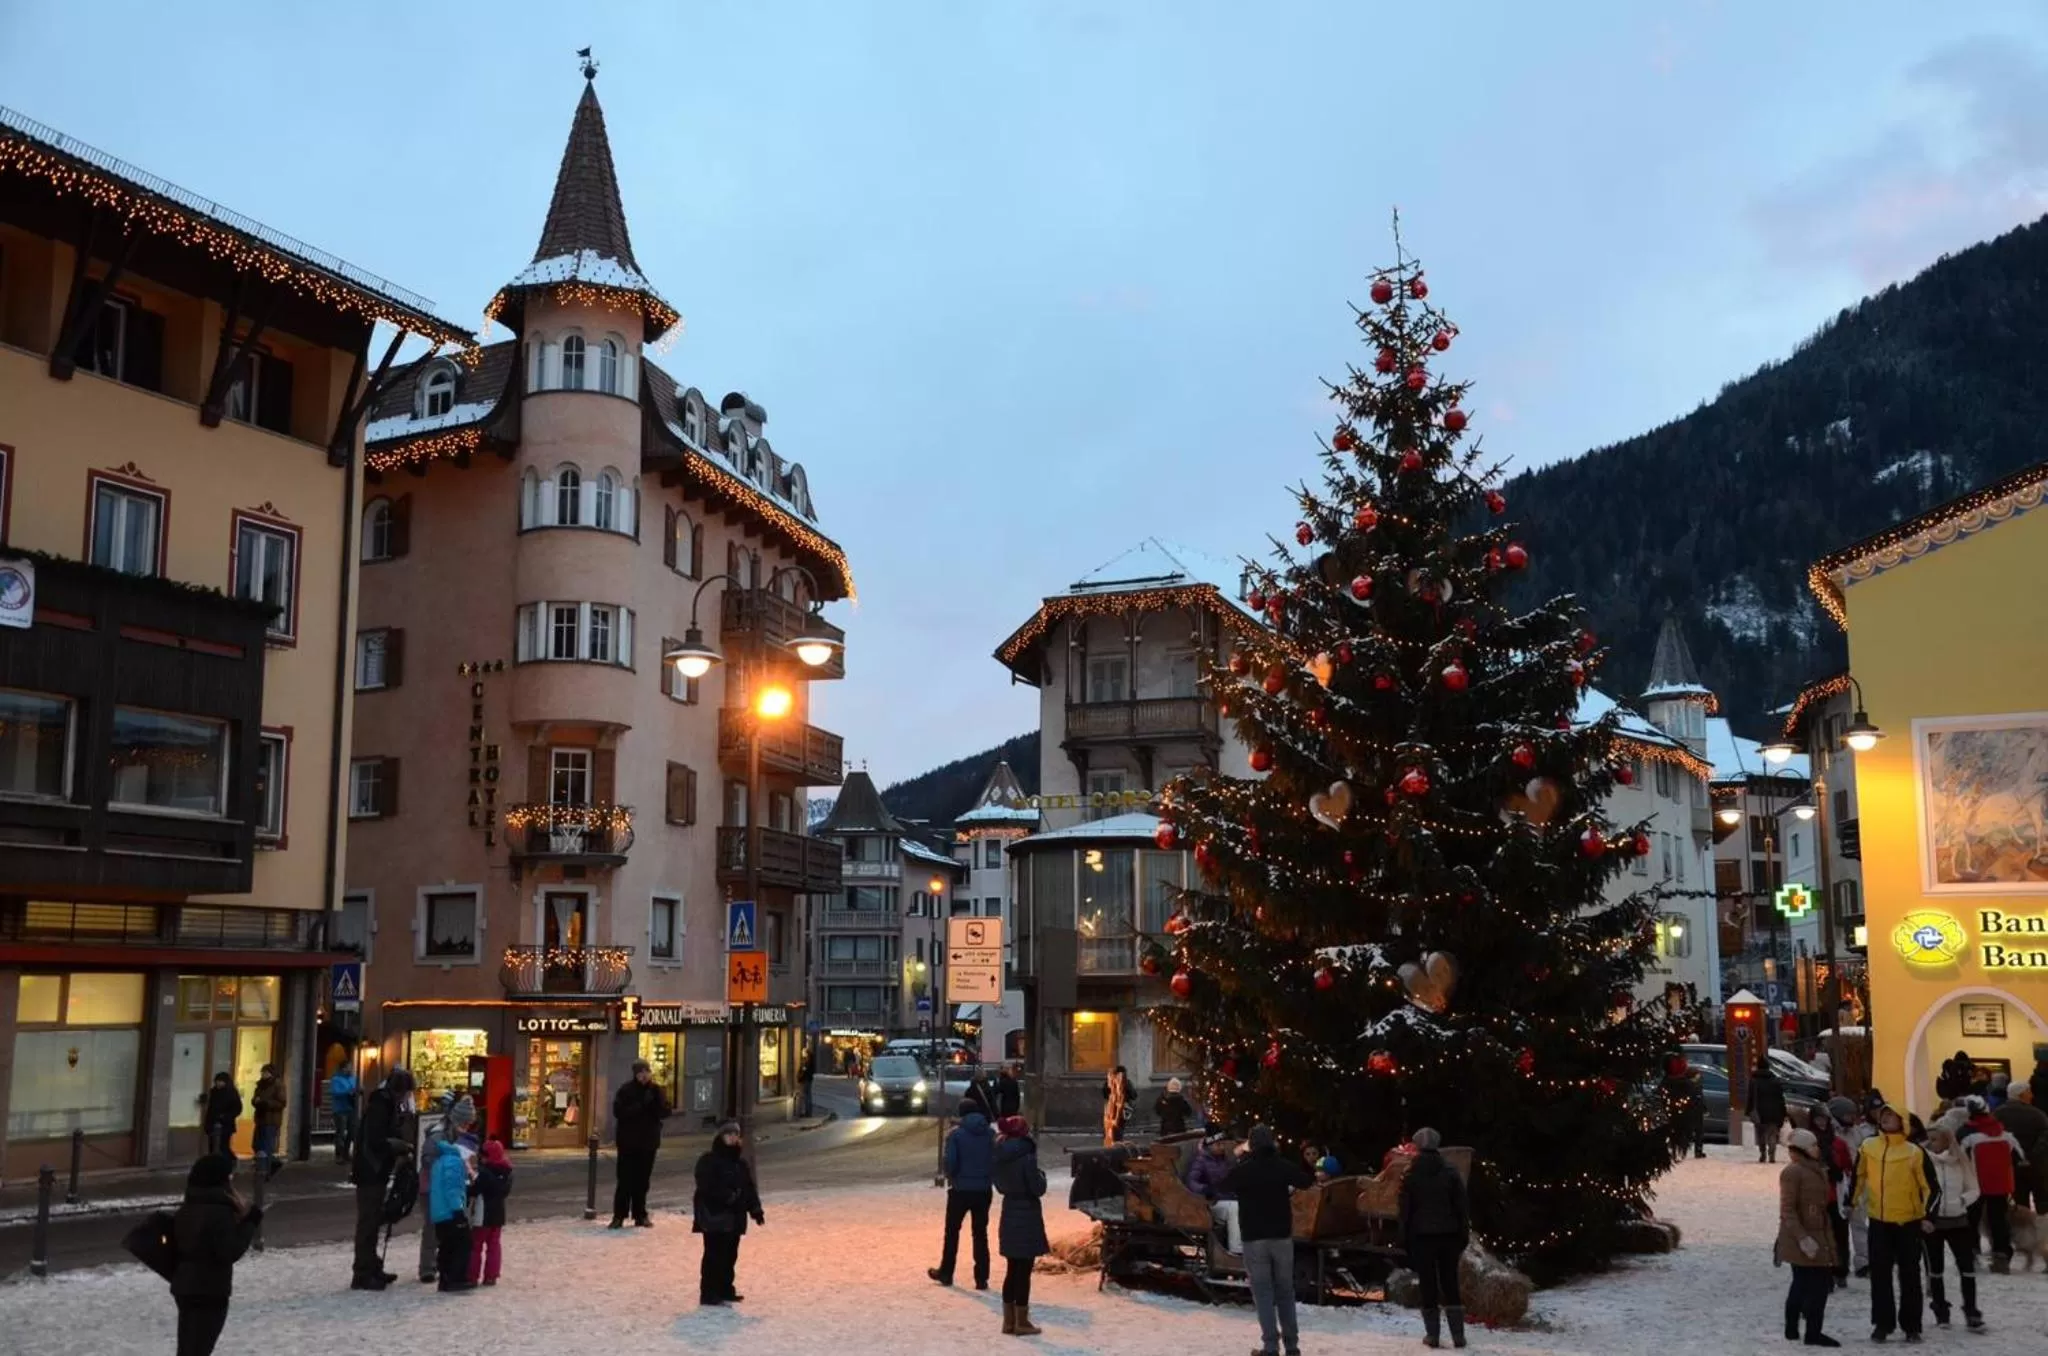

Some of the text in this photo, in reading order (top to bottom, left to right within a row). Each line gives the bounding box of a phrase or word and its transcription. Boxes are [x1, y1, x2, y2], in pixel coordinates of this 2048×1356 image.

[468, 682, 484, 828] CENTRAL
[485, 745, 500, 848] HOTEL
[518, 1019, 570, 1031] LOTTO
[640, 1008, 682, 1025] GIORNALI
